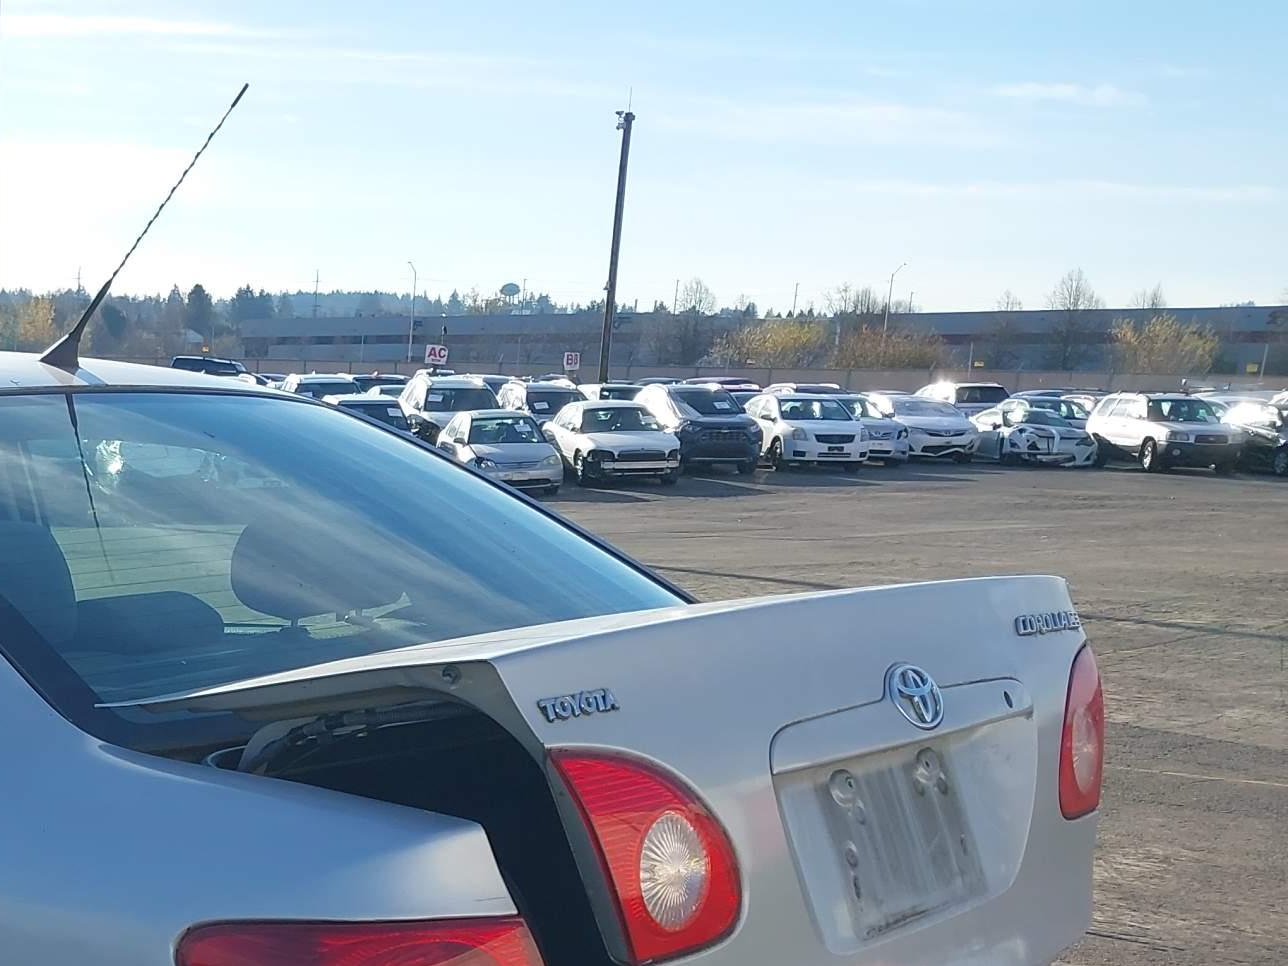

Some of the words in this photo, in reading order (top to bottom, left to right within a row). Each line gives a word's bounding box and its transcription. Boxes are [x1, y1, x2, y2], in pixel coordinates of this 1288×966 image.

[427, 347, 447, 359] AC
[1015, 611, 1071, 636] COROLLA
[537, 688, 620, 723] TOYOTA
